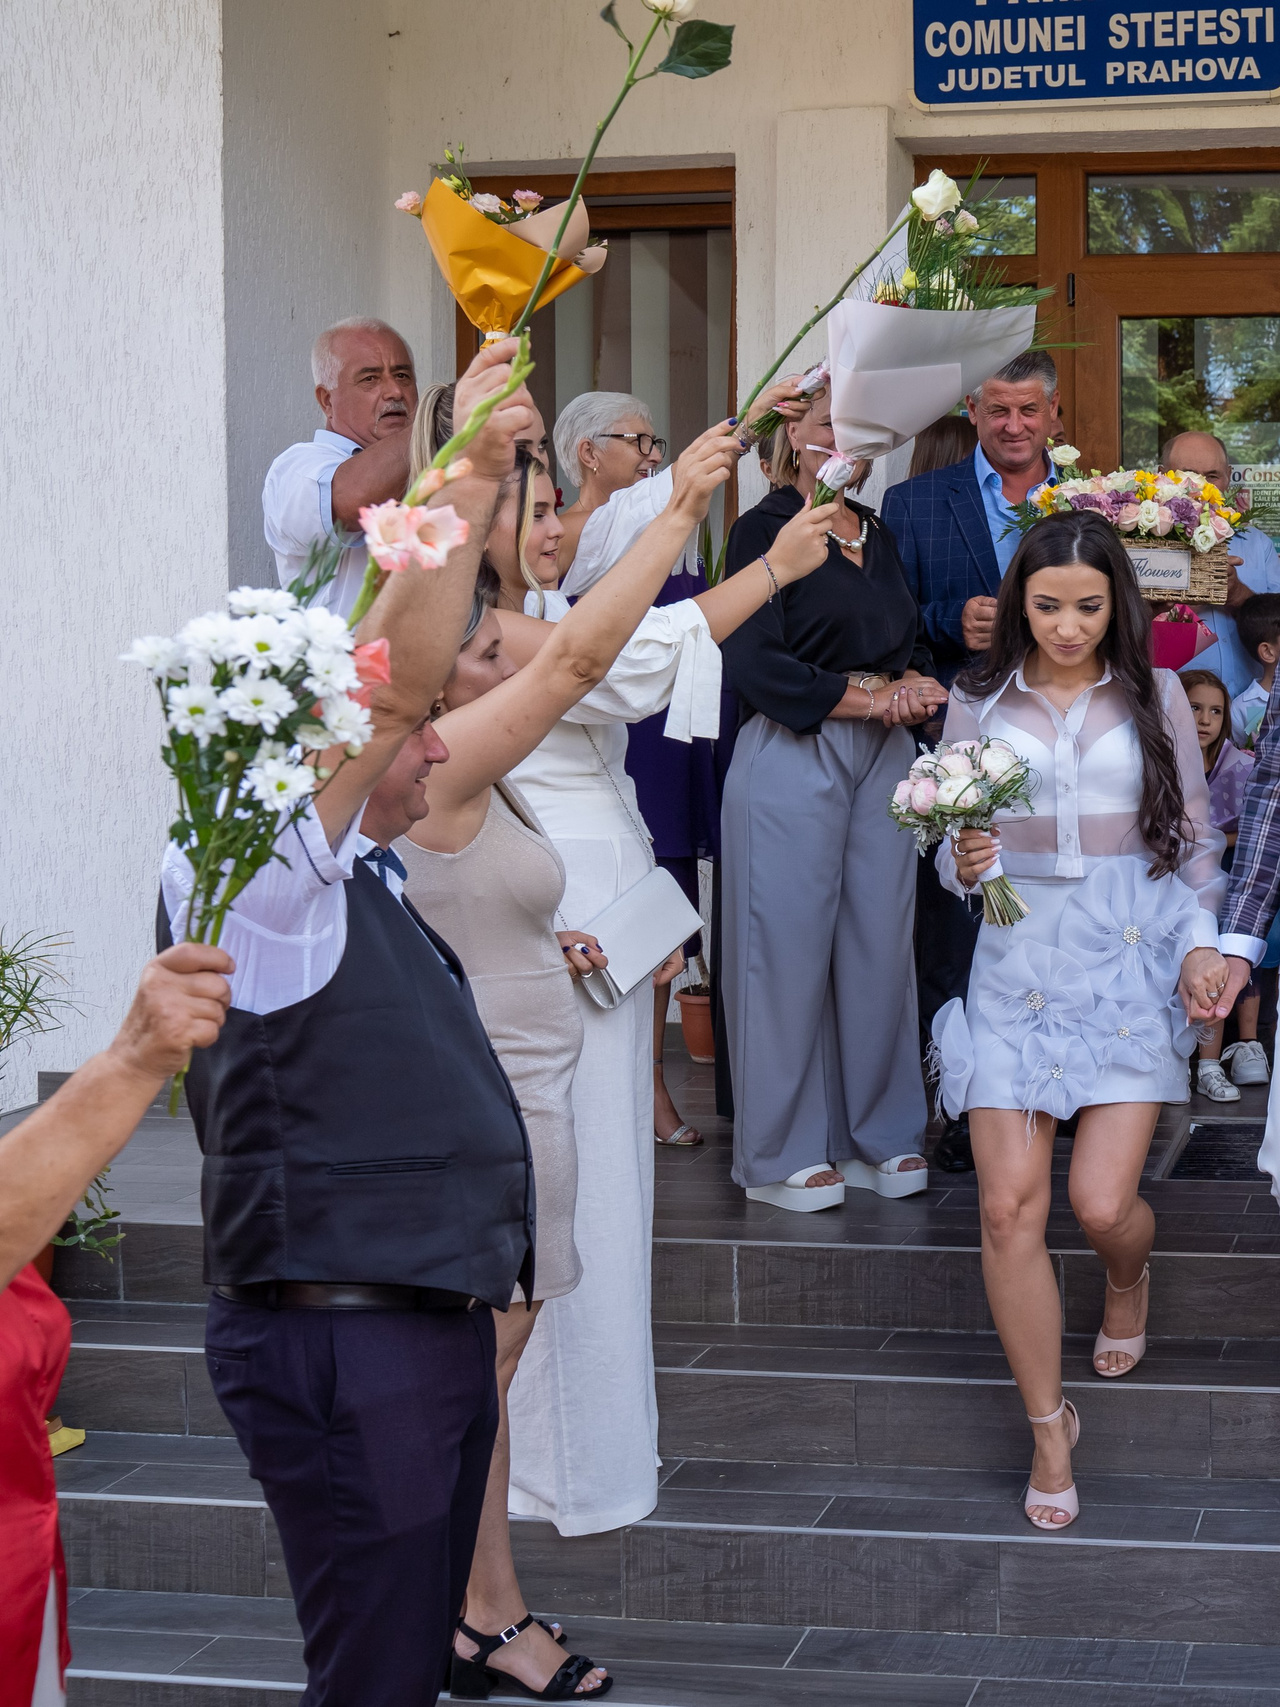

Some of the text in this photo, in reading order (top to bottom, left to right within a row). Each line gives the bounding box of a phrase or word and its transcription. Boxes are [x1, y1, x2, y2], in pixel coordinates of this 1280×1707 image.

[925, 7, 1275, 58] COMUNEI STEFESTI
[938, 56, 1261, 93] JUDETUL PRAHOVA
[1131, 557, 1183, 579] Flowers
